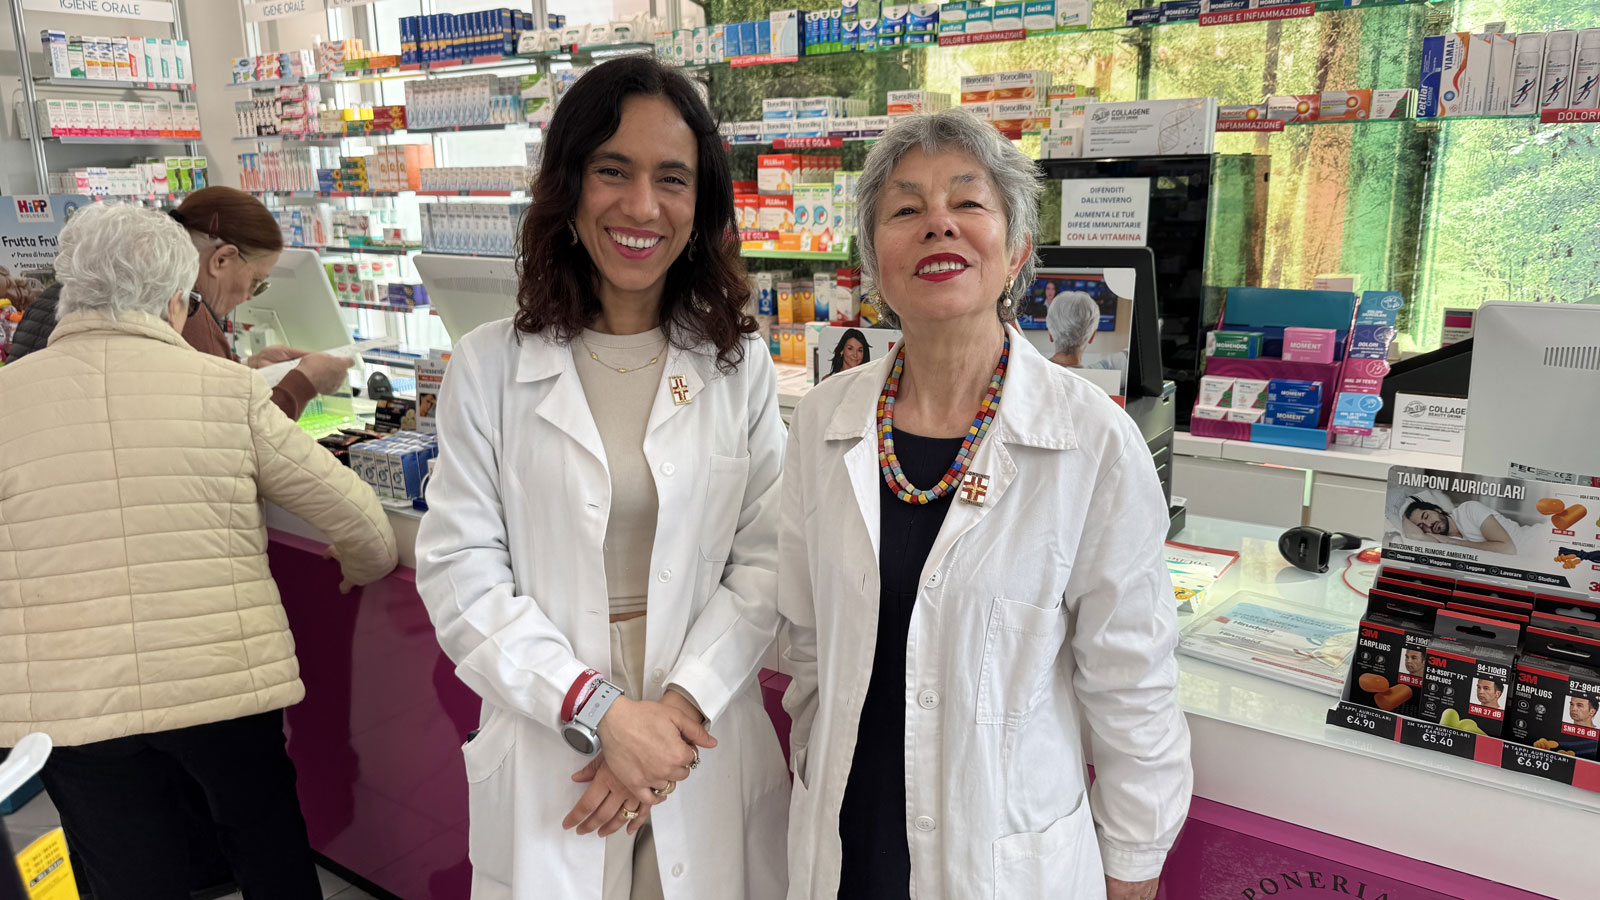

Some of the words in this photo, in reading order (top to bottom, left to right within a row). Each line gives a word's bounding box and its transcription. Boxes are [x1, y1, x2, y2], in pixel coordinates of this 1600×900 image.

[60, 0, 98, 11] IGIENE
[101, 1, 141, 15] ORALE
[284, 0, 305, 13] ORALE
[1202, 14, 1234, 25] DOLORE
[1236, 13, 1241, 21] E
[1243, 7, 1311, 21] INFIAMMAZIONE
[940, 35, 966, 45] DOLORE
[972, 31, 1024, 42] INFIAMMAZIONE
[1444, 38, 1456, 71] VIAMAL
[1000, 72, 1032, 80] Borocillina
[1417, 84, 1429, 116] Cetilar
[999, 104, 1032, 112] Borocillina
[1111, 108, 1150, 116] COLLAGENE
[1217, 121, 1281, 130] INFIAMMAZIONE
[783, 140, 805, 148] TOSSE
[812, 139, 831, 147] GOLA
[17, 200, 48, 213] HiPP
[1, 235, 37, 248] Frutta
[752, 232, 770, 240] GOLA
[1067, 233, 1085, 241] CON
[1100, 233, 1141, 241] VITAMINA
[1216, 342, 1248, 350] MOMENDOL
[1290, 342, 1321, 350] MOMENT
[1428, 405, 1466, 415] COLLAGE
[1276, 413, 1306, 421] MOMENT
[1396, 471, 1449, 491] TAMPONI
[1451, 481, 1526, 500] AURICOLARI
[1388, 542, 1414, 551] RIDUZIONE
[1424, 547, 1446, 556] RUMORE
[1446, 551, 1479, 561] AMBIENTALE
[1466, 564, 1486, 573] Leggere
[1500, 570, 1522, 578] Lavorare
[1589, 581, 1600, 592] 3
[1361, 628, 1379, 639] 3M
[1405, 634, 1428, 645] 94-110d
[1359, 638, 1391, 652] EARPLUGS
[1427, 656, 1447, 668] 3M
[1477, 664, 1507, 676] 94-110dB
[1425, 673, 1452, 685] EARPLUGS
[1518, 673, 1538, 685] 3M
[1516, 683, 1553, 699] EARPLUGS
[1358, 709, 1392, 721] AURICOLARI
[1470, 706, 1482, 714] SNR
[1346, 715, 1376, 730] €4.90
[1425, 729, 1452, 738] EARSOFT
[1435, 727, 1471, 738] AURICOLARI
[1563, 725, 1576, 733] SNR
[1586, 730, 1597, 738] dB
[1422, 733, 1453, 747] €5.40
[1515, 751, 1543, 761] EARSOFT
[1531, 750, 1569, 763] AURICOLARI
[1517, 756, 1550, 771] €6.90
